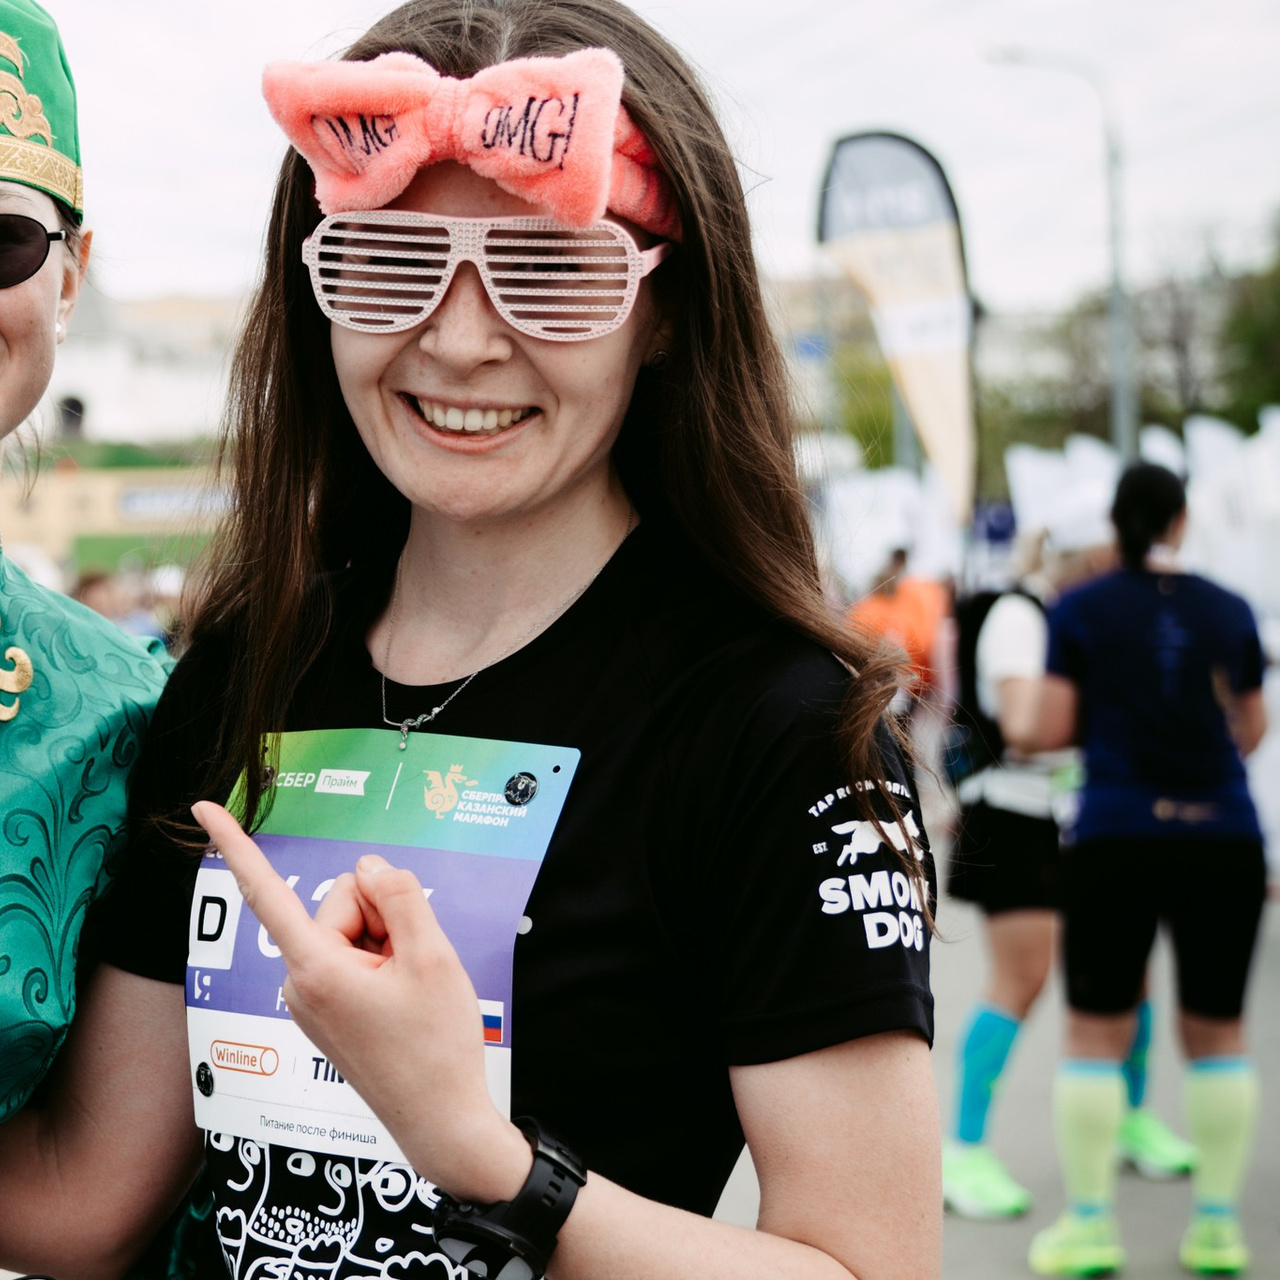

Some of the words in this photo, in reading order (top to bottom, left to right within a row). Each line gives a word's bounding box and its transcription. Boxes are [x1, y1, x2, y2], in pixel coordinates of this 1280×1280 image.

[276, 772, 316, 788] СБЕР
[322, 775, 358, 789] Прайм
[457, 802, 527, 817] КАЗАНСКИЙ
[807, 793, 835, 818] TAP
[454, 813, 509, 827] МАРАФОН
[196, 895, 228, 943] D
[862, 910, 924, 952] DOG
[214, 1046, 258, 1067] Winline
[259, 1114, 295, 1133] Питание
[295, 1124, 327, 1138] после
[328, 1127, 377, 1145] финиша
